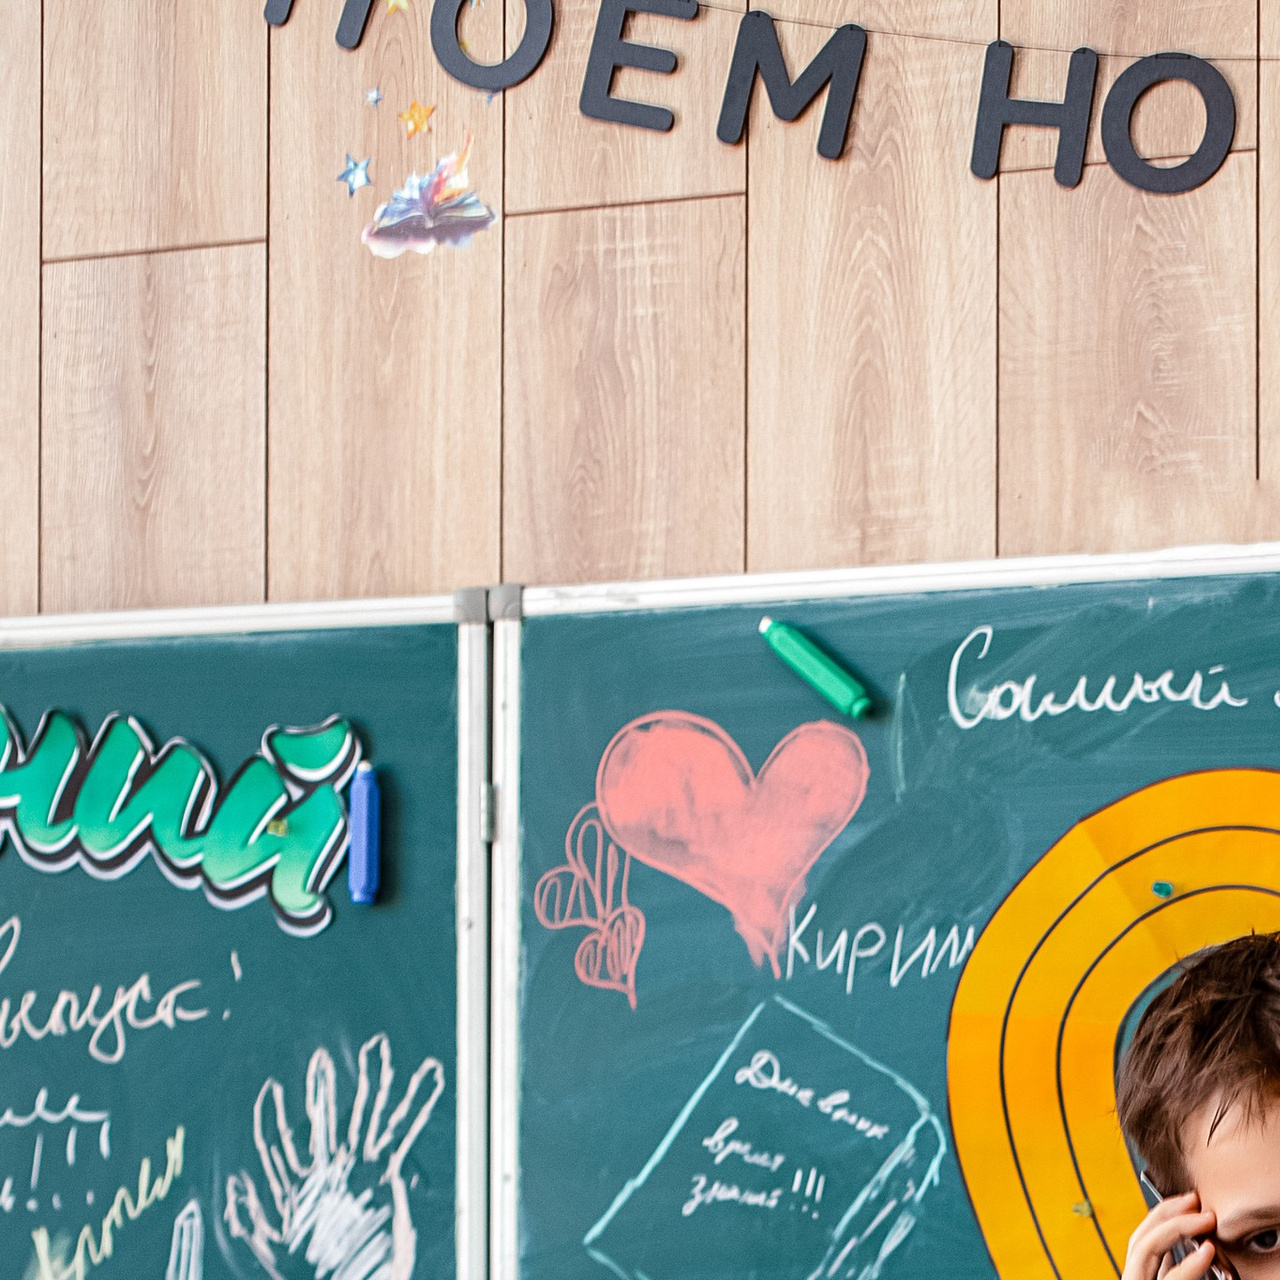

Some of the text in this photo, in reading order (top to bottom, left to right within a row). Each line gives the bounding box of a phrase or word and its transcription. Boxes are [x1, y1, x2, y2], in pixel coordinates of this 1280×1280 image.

[264, 0, 868, 160] ОЕМ
[969, 40, 1237, 196] НО
[948, 625, 1248, 730] Самый
